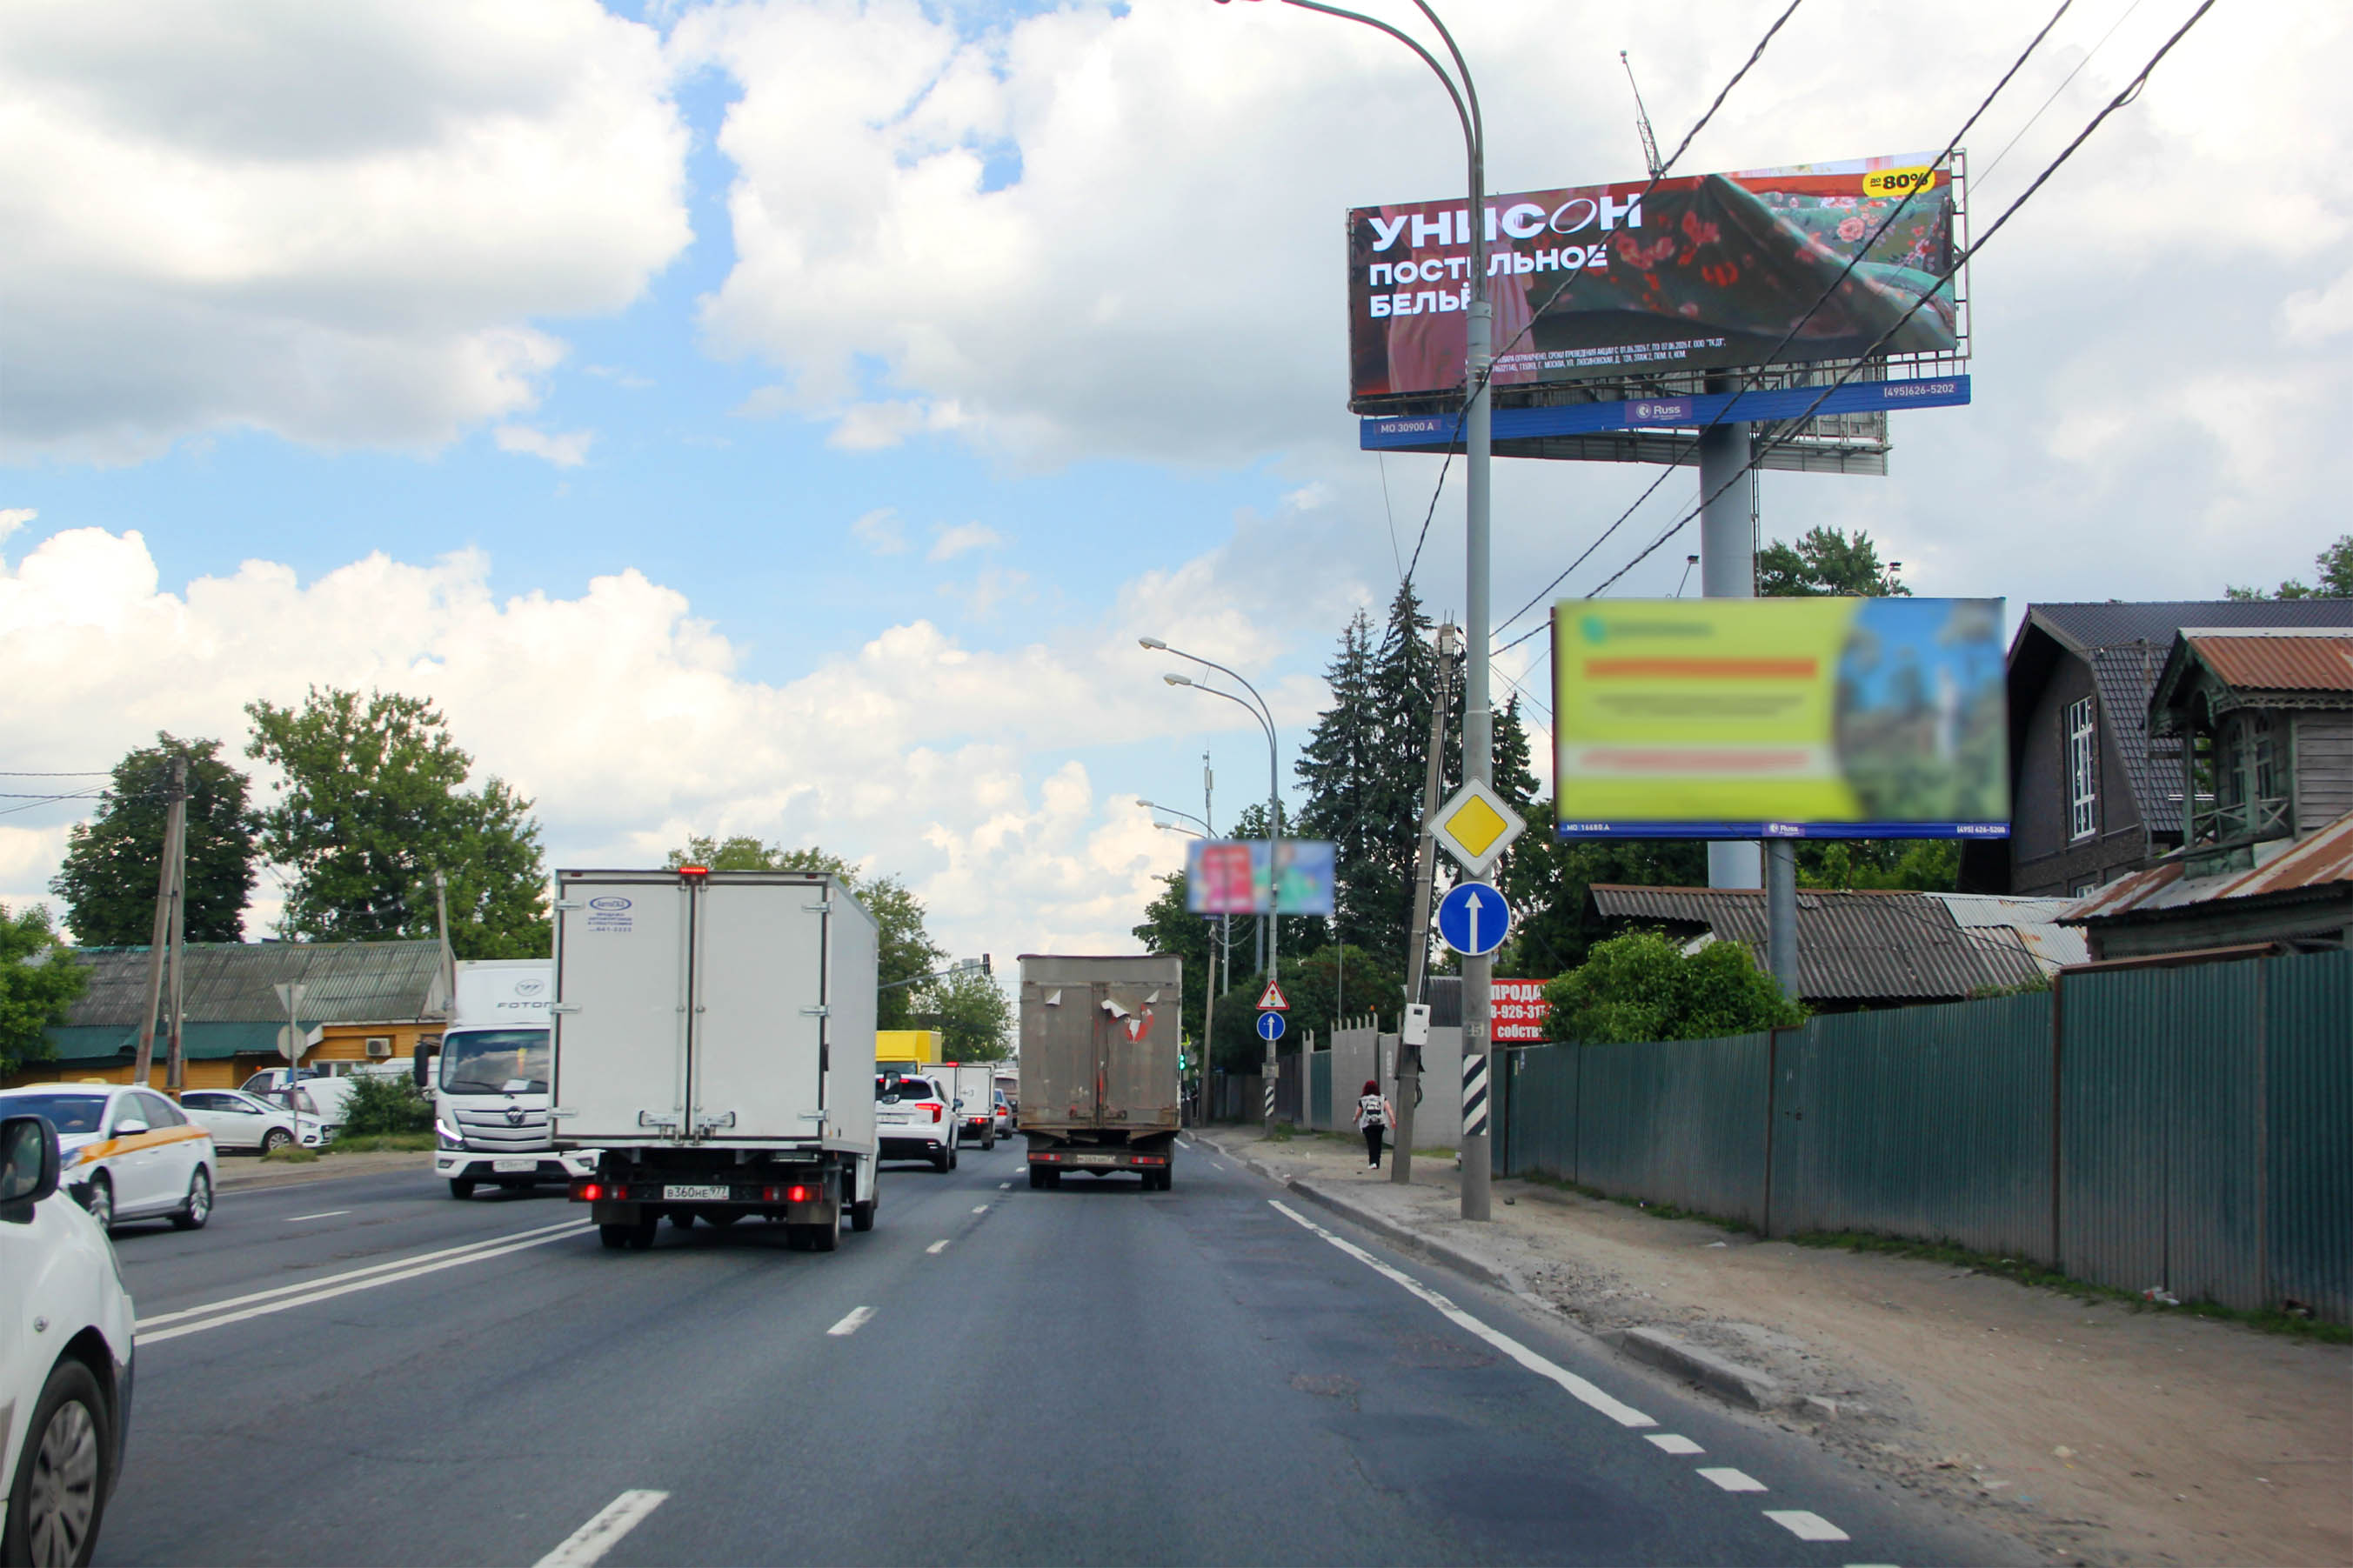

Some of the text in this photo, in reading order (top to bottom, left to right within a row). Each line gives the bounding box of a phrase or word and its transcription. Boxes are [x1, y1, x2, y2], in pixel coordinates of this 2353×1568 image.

[1883, 173, 1928, 189] 80%
[1368, 193, 1641, 251] УНИСОН
[1370, 244, 1608, 285] ПОСТЛЬНОЕ
[1654, 405, 1681, 415] Russ
[1398, 423, 1425, 432] 30900
[1491, 984, 1545, 1002] ПРОДА
[1497, 1024, 1543, 1038] собств
